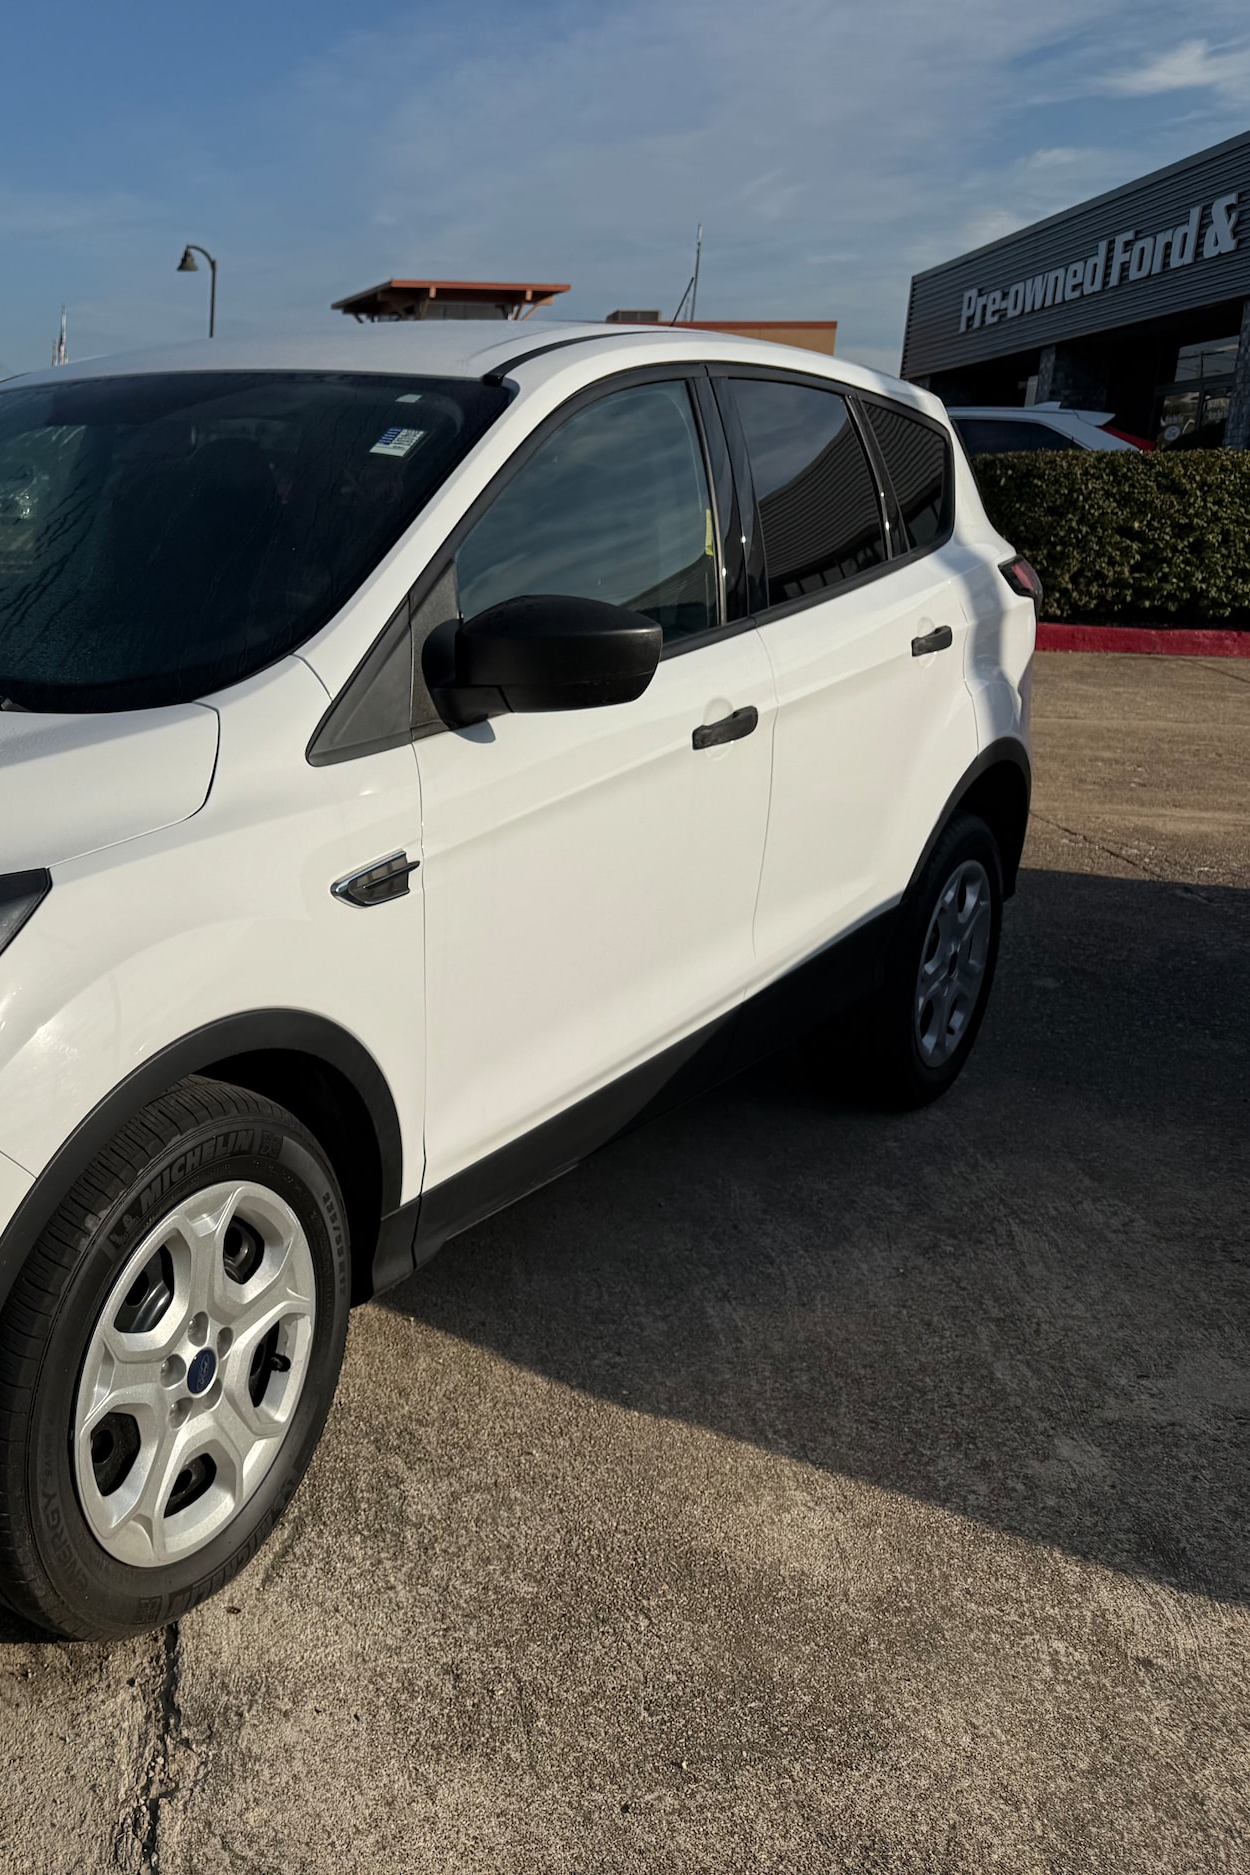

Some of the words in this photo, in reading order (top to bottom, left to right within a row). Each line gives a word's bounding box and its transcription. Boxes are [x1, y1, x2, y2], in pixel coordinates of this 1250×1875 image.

[959, 240, 1108, 333] Pre-owned
[1107, 206, 1201, 289] Ford
[1203, 193, 1240, 258] &
[140, 1129, 254, 1214] MICHELIN
